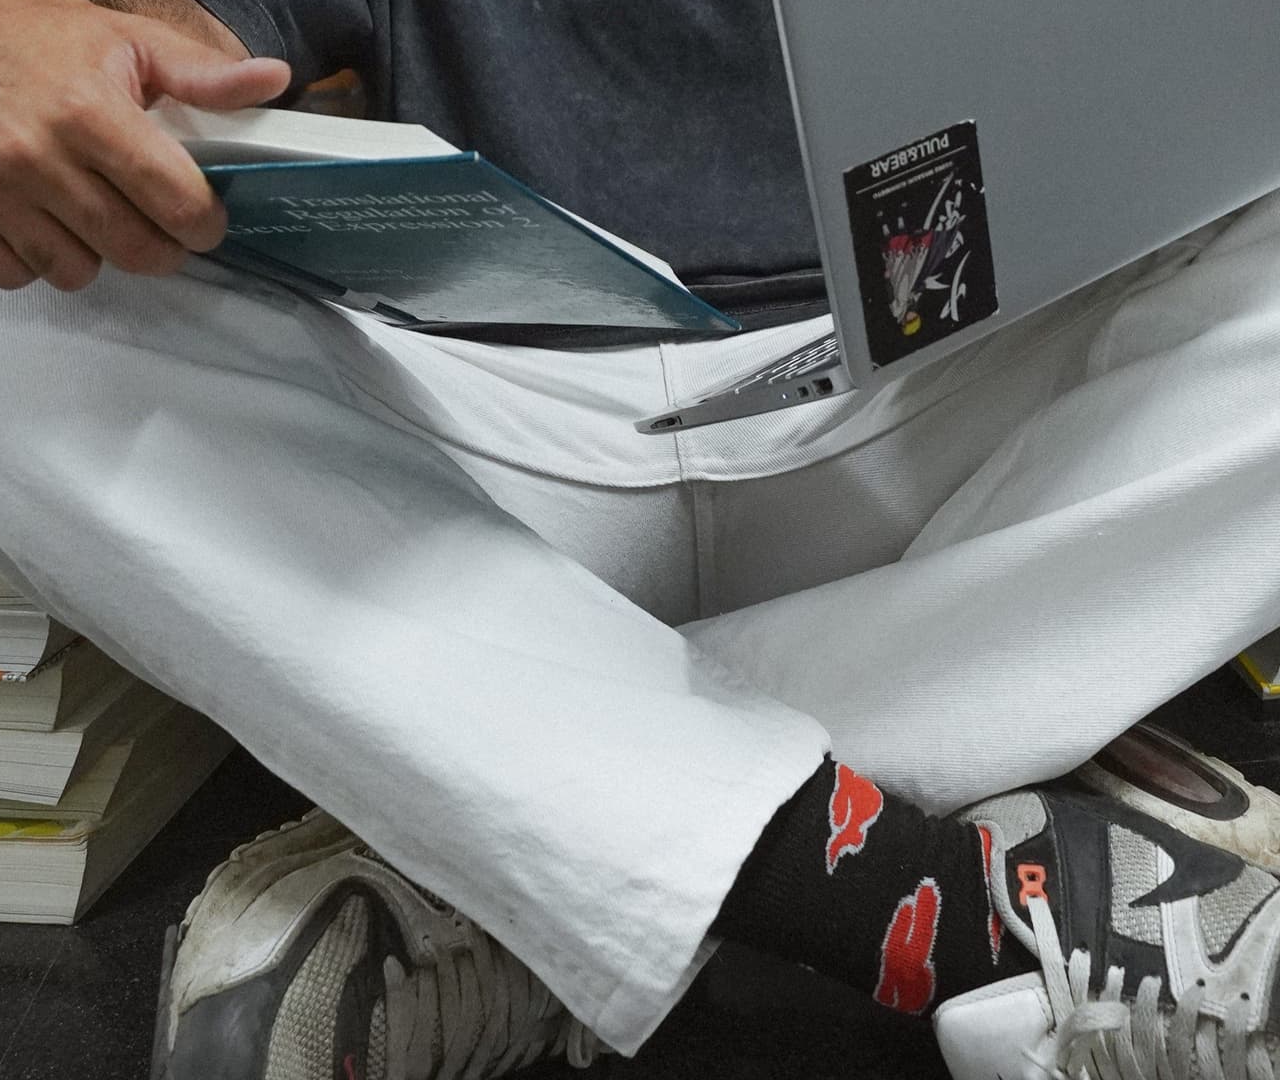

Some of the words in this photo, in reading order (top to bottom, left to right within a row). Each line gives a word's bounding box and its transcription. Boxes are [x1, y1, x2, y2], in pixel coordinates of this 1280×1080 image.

[870, 132, 951, 178] PULL&BEAR
[270, 190, 499, 209] Translational
[285, 204, 471, 221] Regulation
[482, 203, 519, 218] of
[226, 222, 312, 234] Gene
[317, 218, 505, 234] Expression
